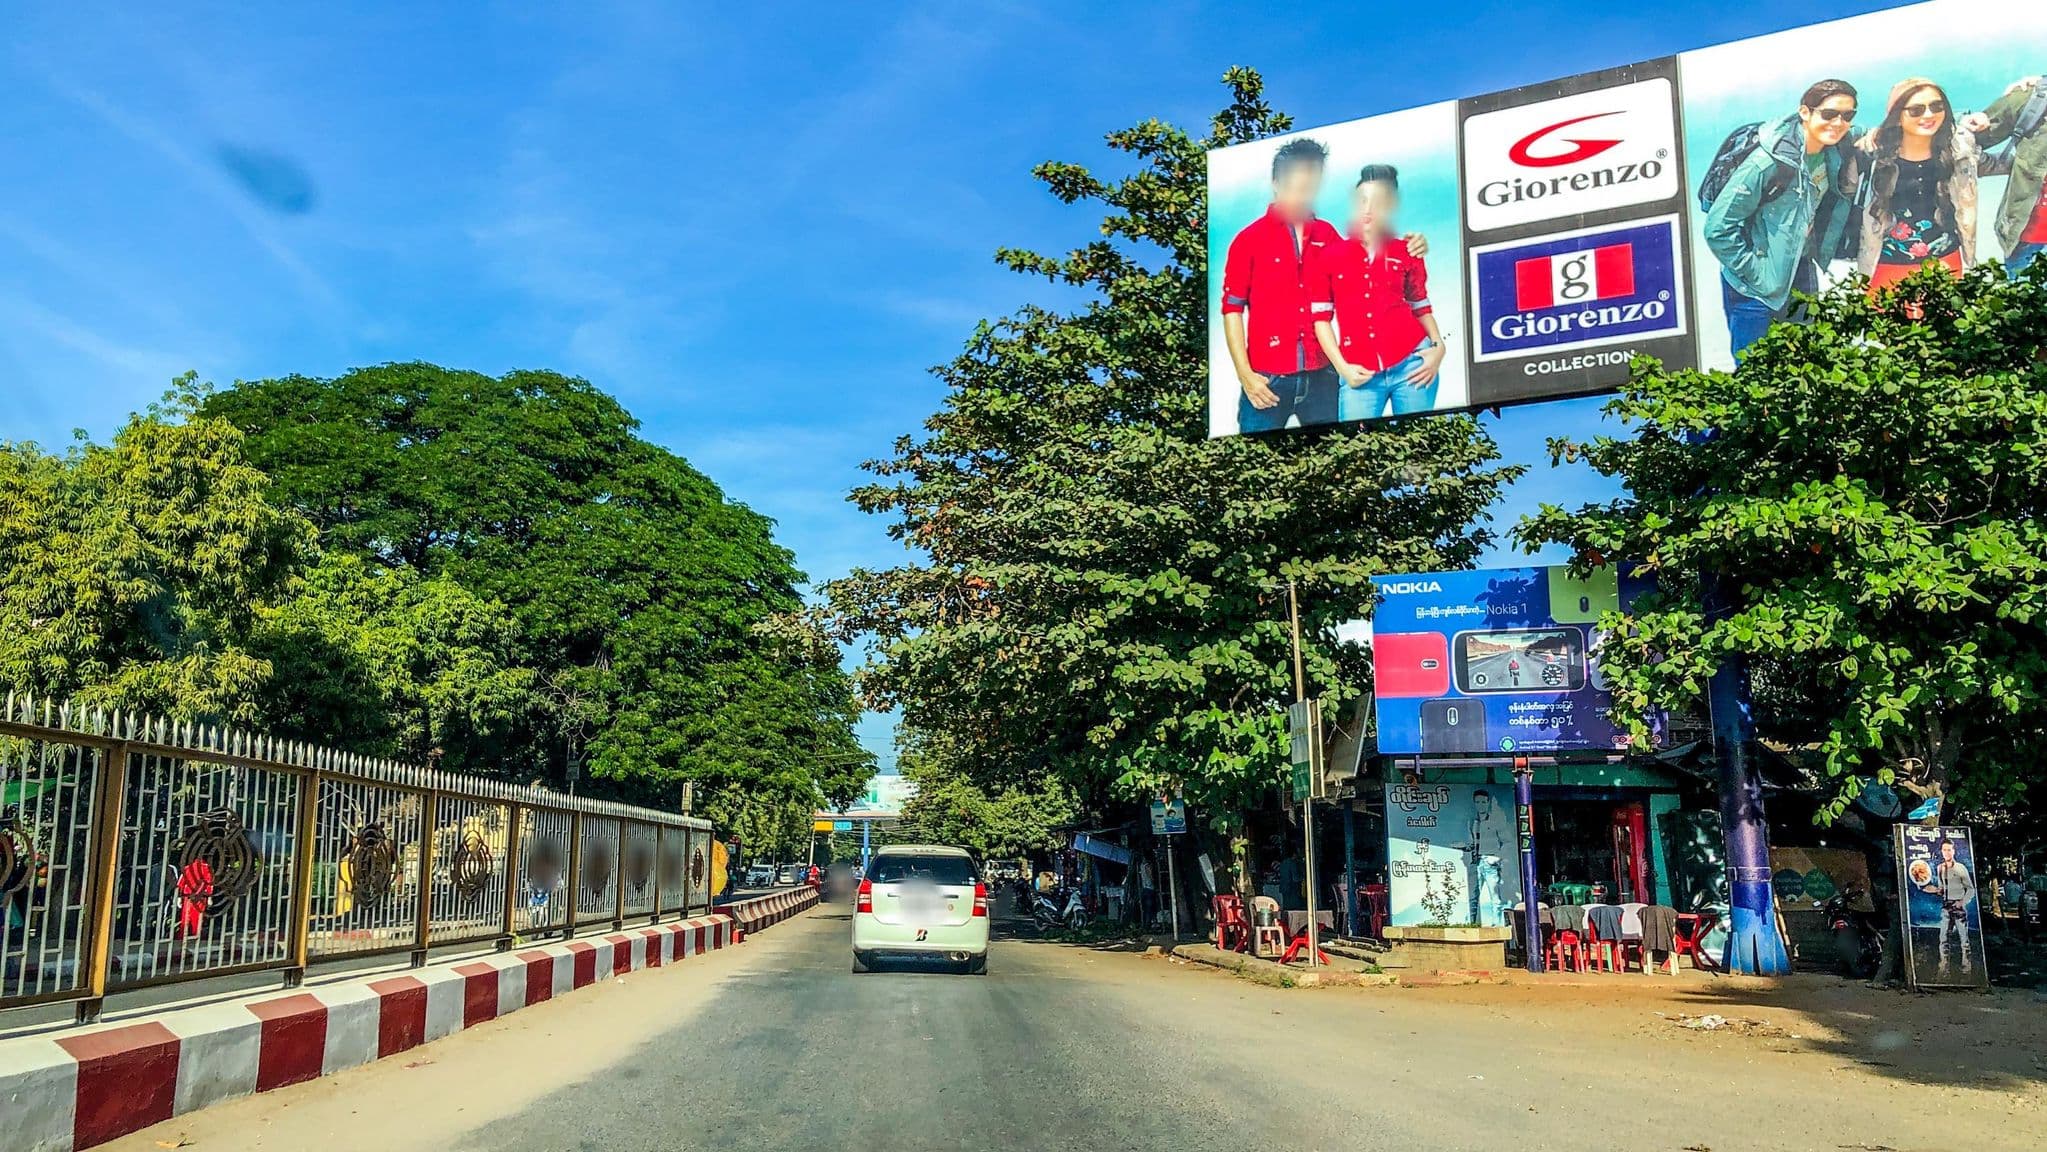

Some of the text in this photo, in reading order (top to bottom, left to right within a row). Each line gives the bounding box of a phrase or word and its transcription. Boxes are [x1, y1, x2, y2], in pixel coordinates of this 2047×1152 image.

[1560, 254, 1590, 299] g
[1523, 350, 1635, 376] COLLECTION
[1382, 581, 1443, 595] NOKIA
[1486, 604, 1518, 615] Nokia
[1521, 603, 1527, 614] 1
